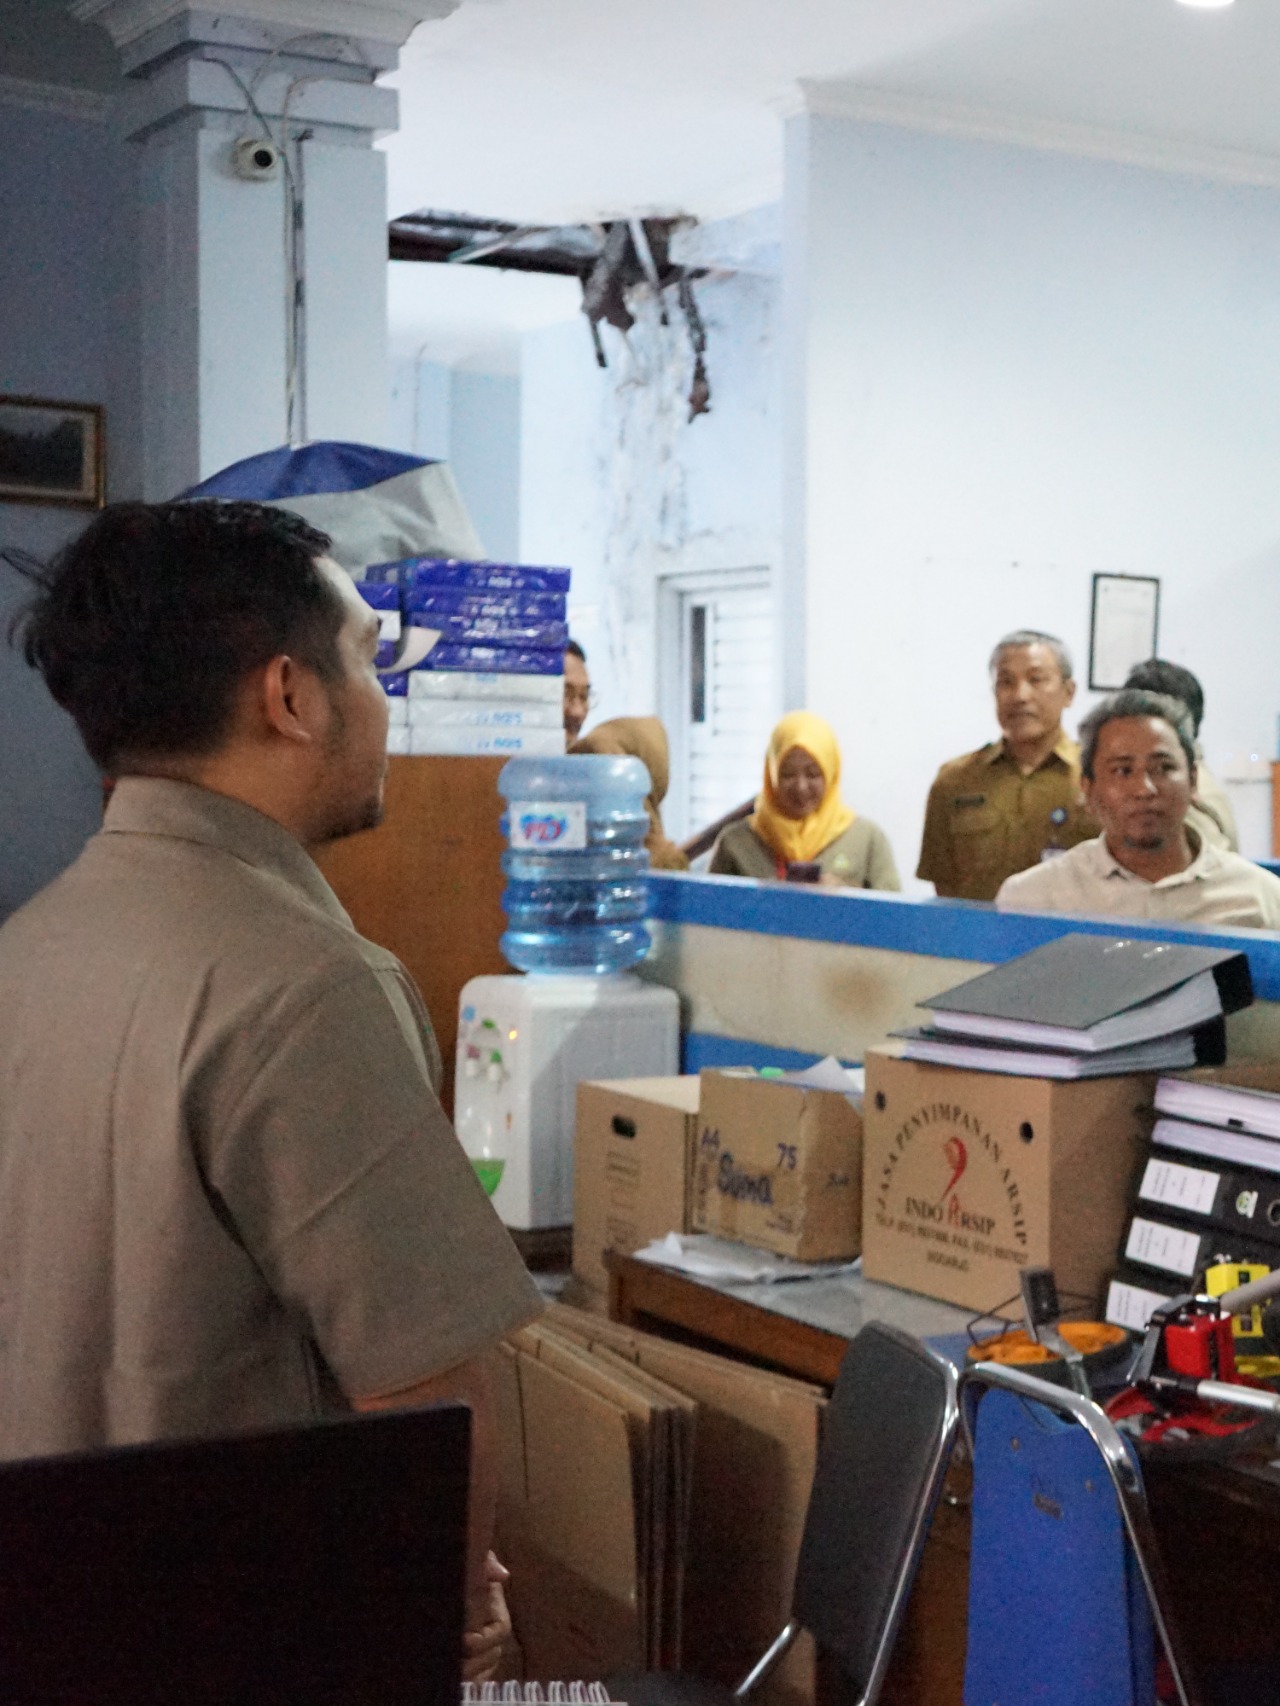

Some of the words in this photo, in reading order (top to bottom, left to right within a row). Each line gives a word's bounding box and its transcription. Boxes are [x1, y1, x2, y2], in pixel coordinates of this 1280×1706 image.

[777, 1142, 798, 1171] 75
[877, 1152, 898, 1210] JASA
[896, 1102, 1002, 1163] PENYIMPANAN
[1001, 1168, 1028, 1246] ARSIP
[905, 1196, 945, 1224] INDO
